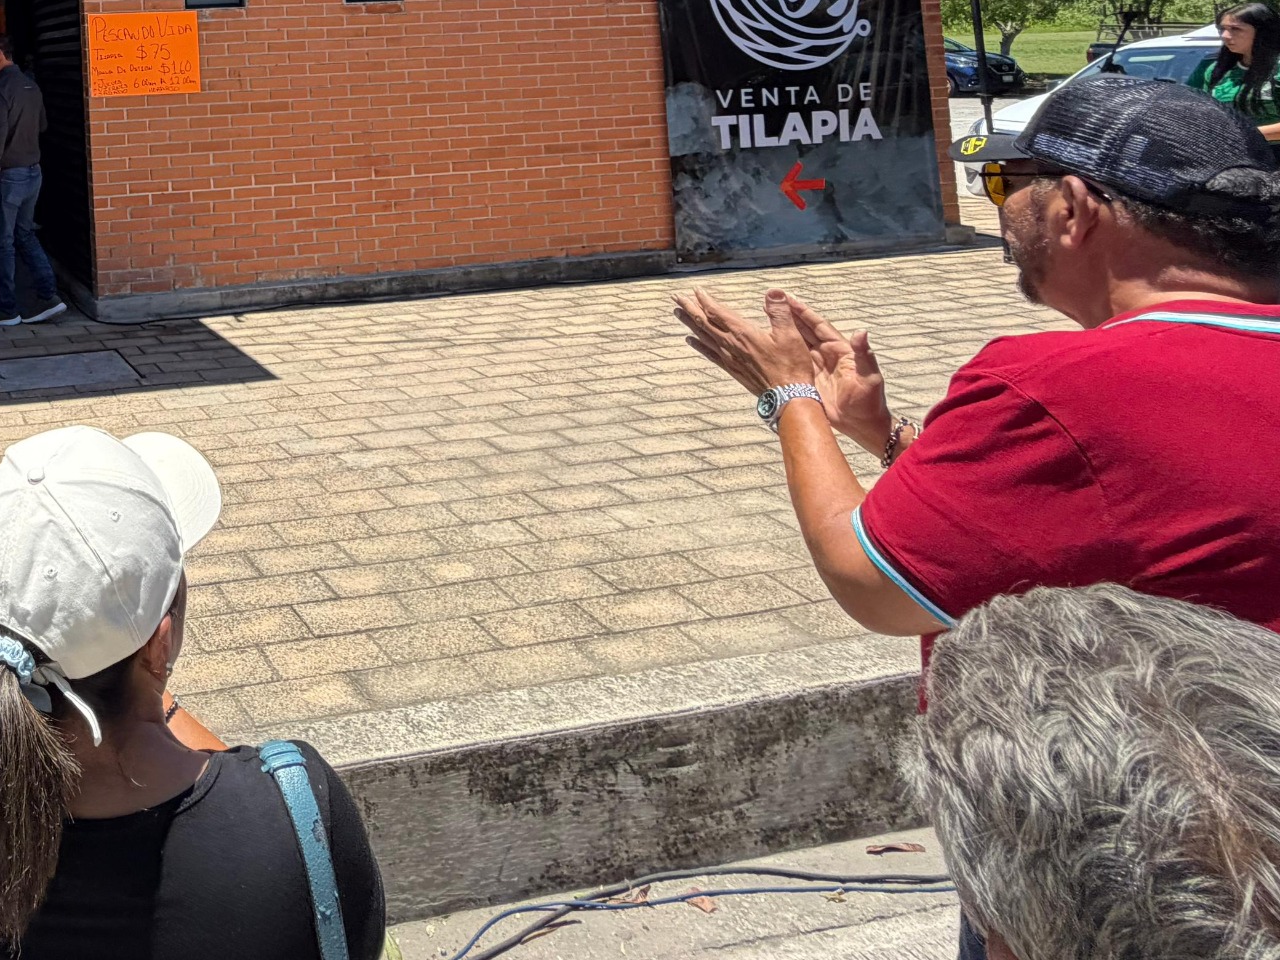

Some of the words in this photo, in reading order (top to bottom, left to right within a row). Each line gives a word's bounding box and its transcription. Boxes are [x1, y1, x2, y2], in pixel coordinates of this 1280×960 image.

[156, 15, 193, 38] VIDA
[136, 43, 171, 61] $75
[158, 60, 192, 76] $160
[715, 85, 821, 109] VENTA
[837, 82, 872, 103] DE
[711, 107, 883, 150] TILAPIA
